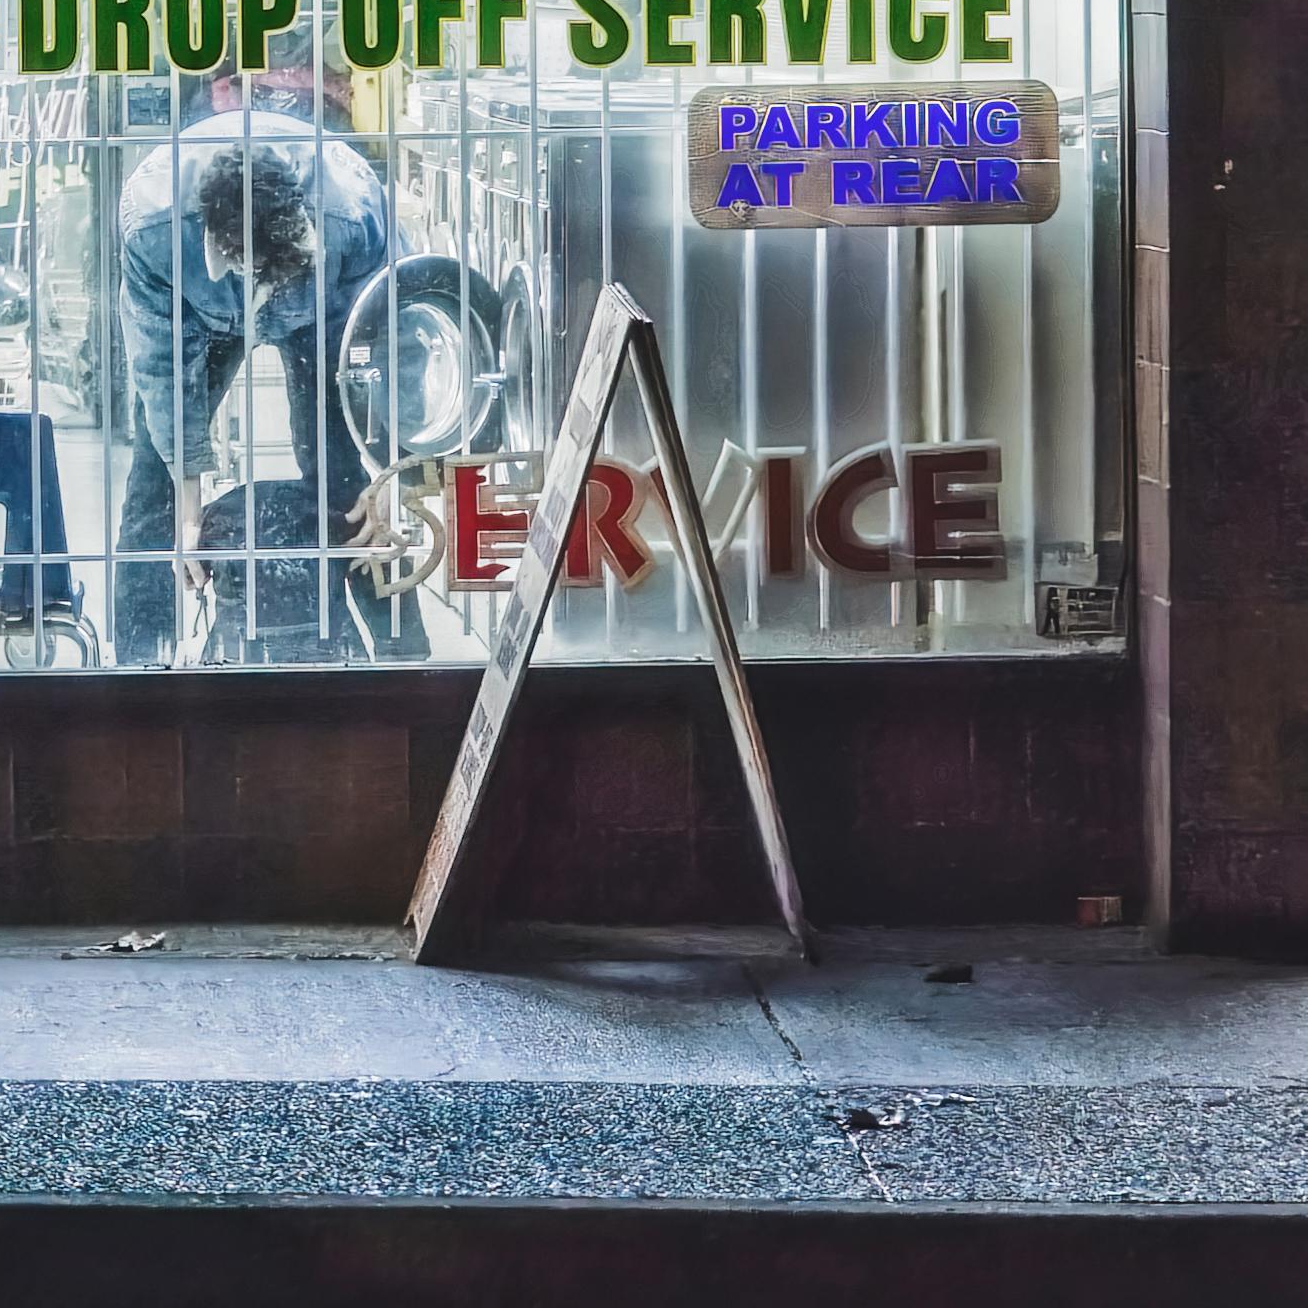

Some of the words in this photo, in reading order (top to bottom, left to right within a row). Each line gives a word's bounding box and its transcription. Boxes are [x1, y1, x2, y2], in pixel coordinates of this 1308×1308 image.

[718, 98, 1022, 152] PARKING
[715, 160, 805, 211] AT
[831, 157, 1022, 206] REAR
